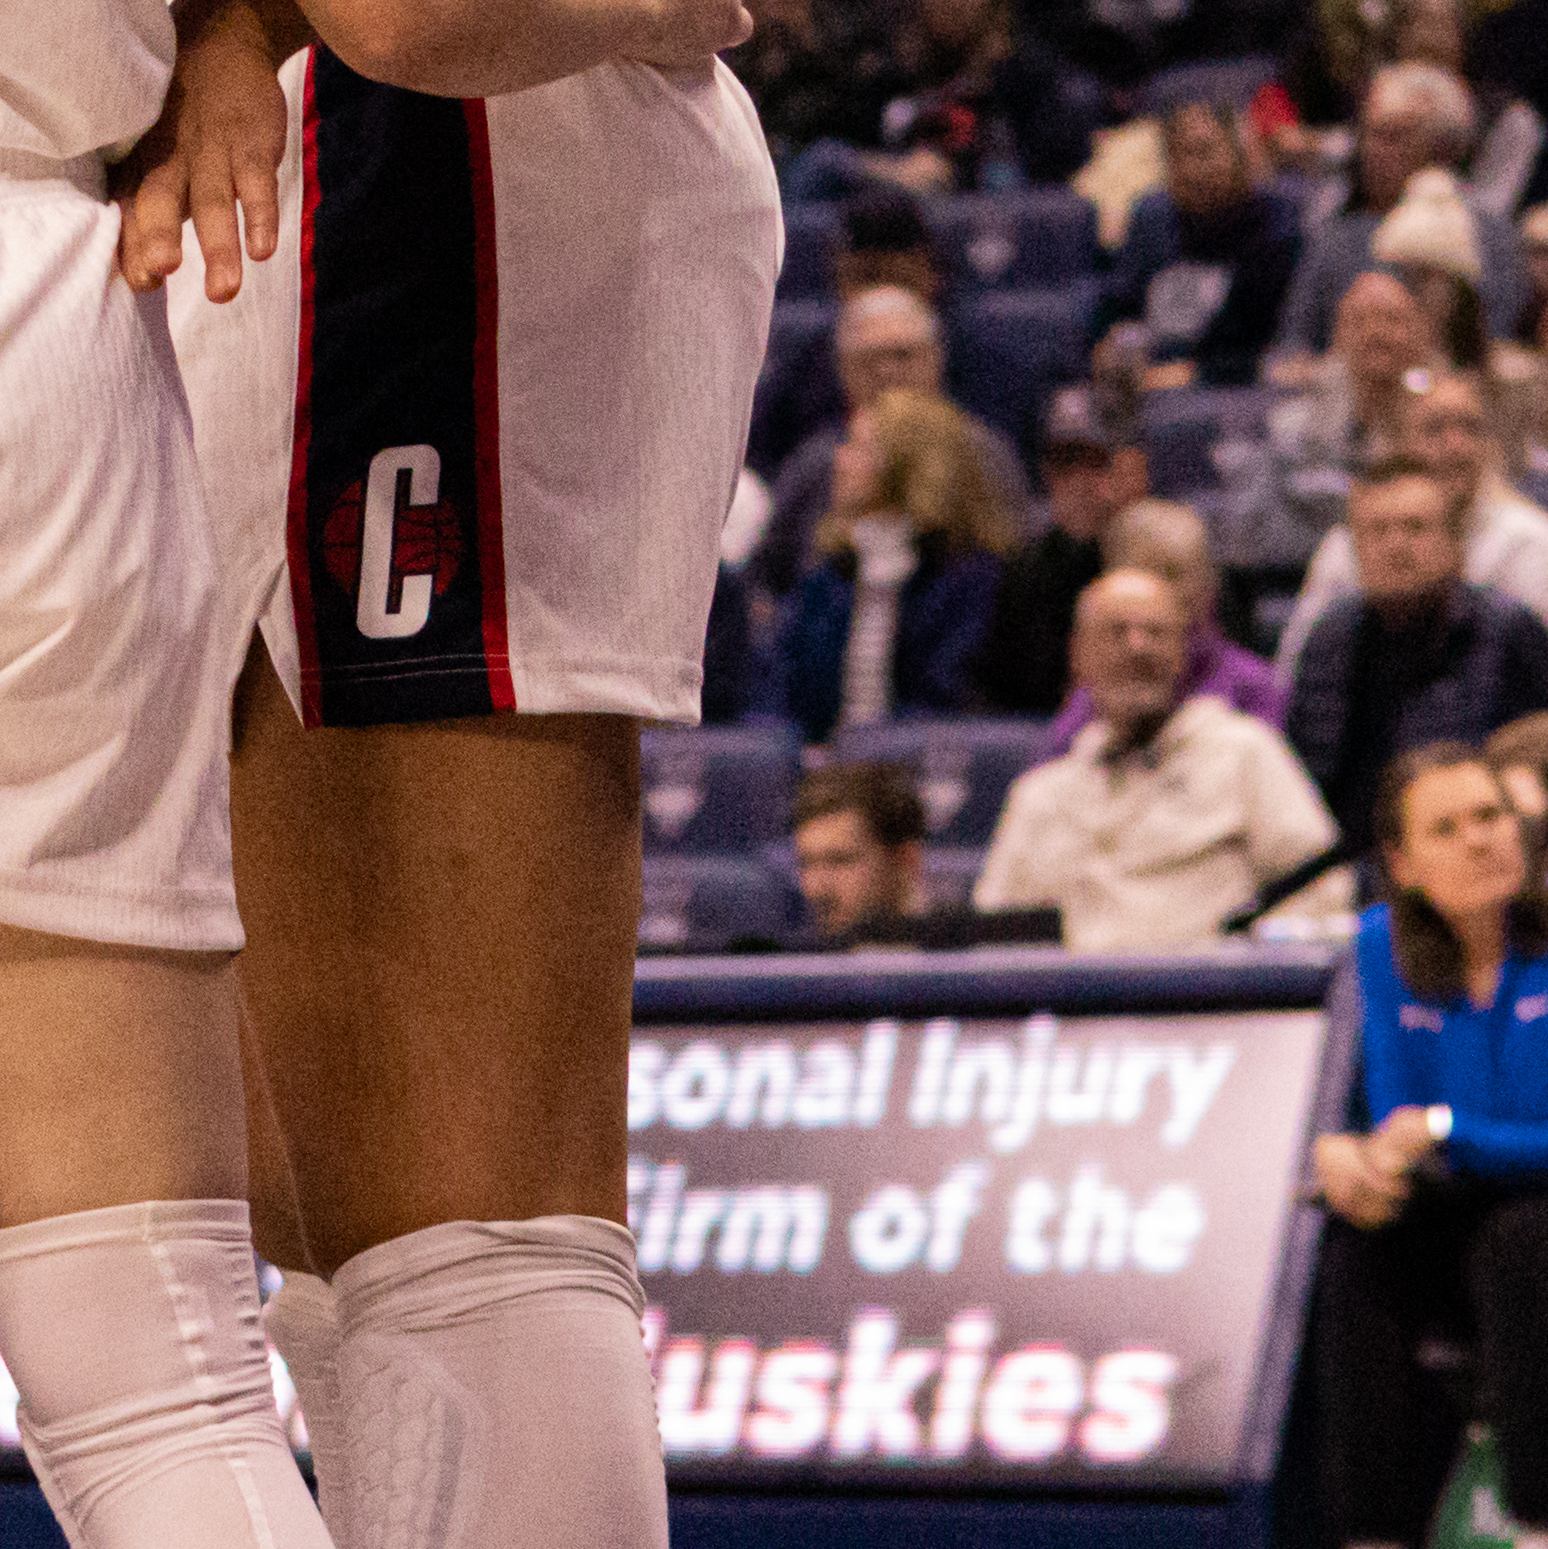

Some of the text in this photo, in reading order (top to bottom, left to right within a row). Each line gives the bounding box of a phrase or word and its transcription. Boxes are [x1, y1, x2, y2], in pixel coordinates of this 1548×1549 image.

[356, 443, 442, 640] C
[627, 1011, 1236, 1151] sonal Injury
[850, 1160, 989, 1274] of
[1007, 1163, 1205, 1274] the
[640, 1305, 1178, 1460] uskies
